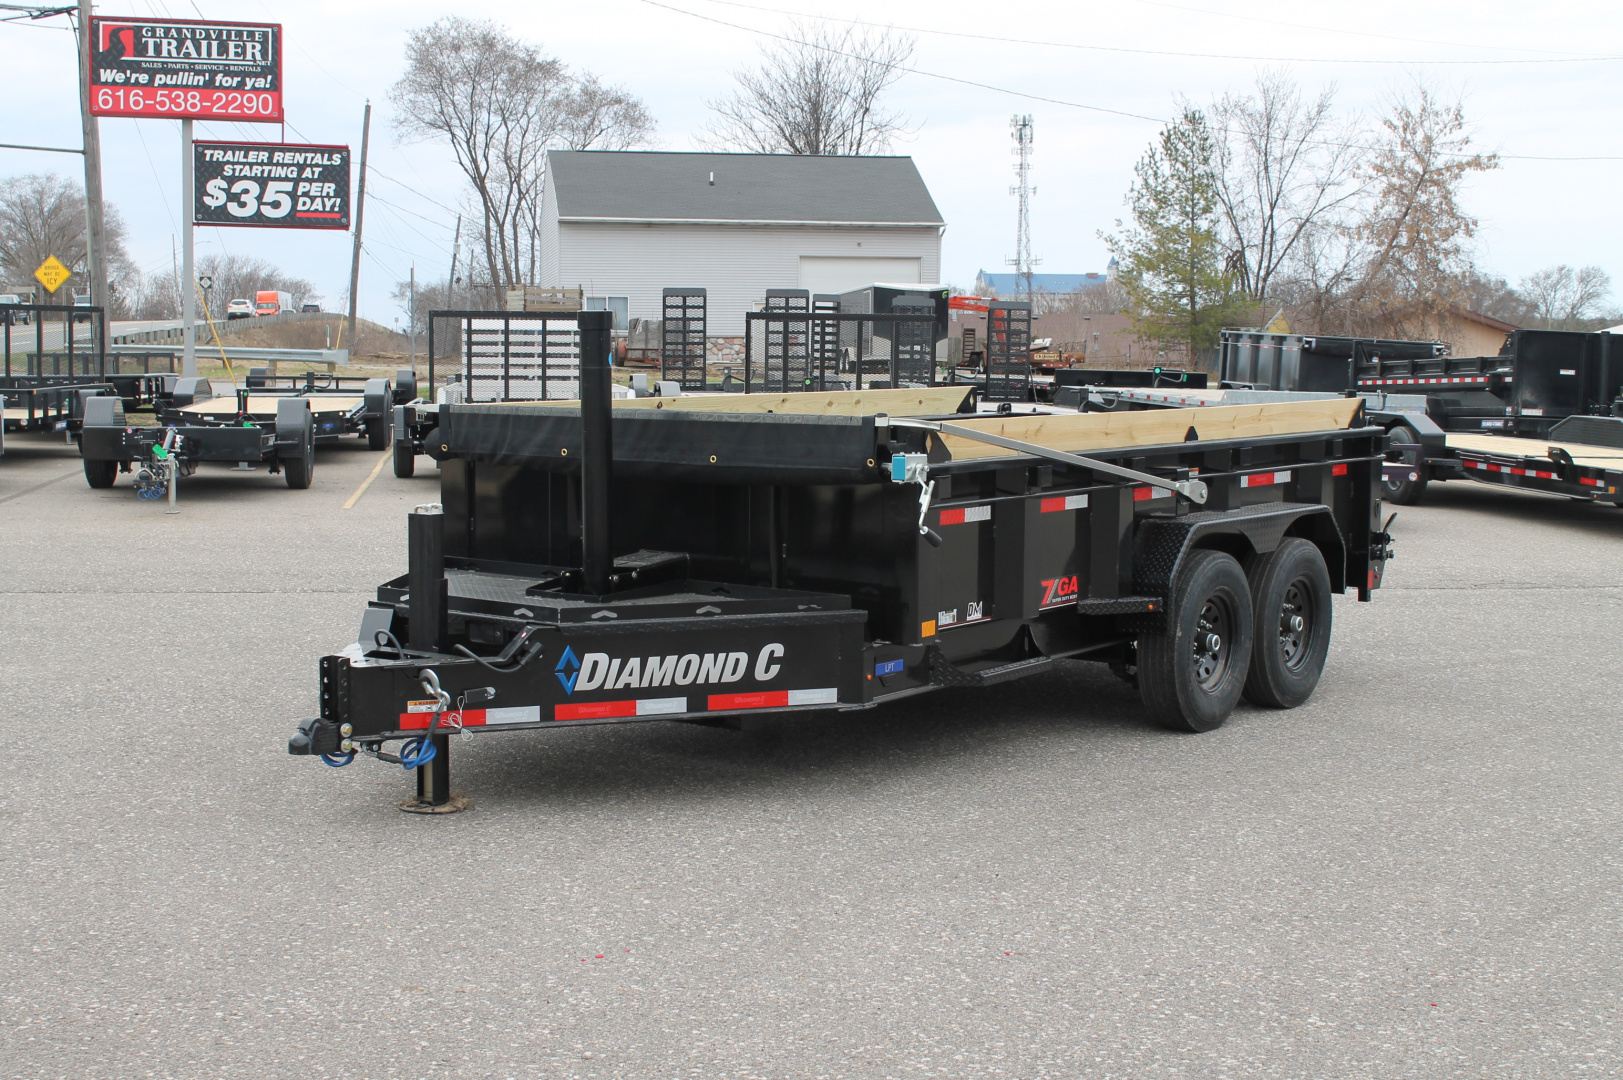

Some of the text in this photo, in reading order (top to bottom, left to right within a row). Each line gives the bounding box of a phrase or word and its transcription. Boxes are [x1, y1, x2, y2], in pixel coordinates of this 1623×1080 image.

[142, 27, 263, 41] GRANDVILLE
[141, 38, 262, 60] TRAILER
[100, 68, 272, 90] We're pullin' for ya!
[98, 88, 273, 114] 616-538-2290
[204, 150, 342, 166] TRAILER RENTALS
[223, 164, 322, 179] STARTING AT
[203, 176, 294, 218] $35
[296, 182, 336, 197] PER
[296, 197, 341, 212] DAY!
[574, 642, 784, 692] DIAMOND C
[885, 662, 894, 672] LPT
